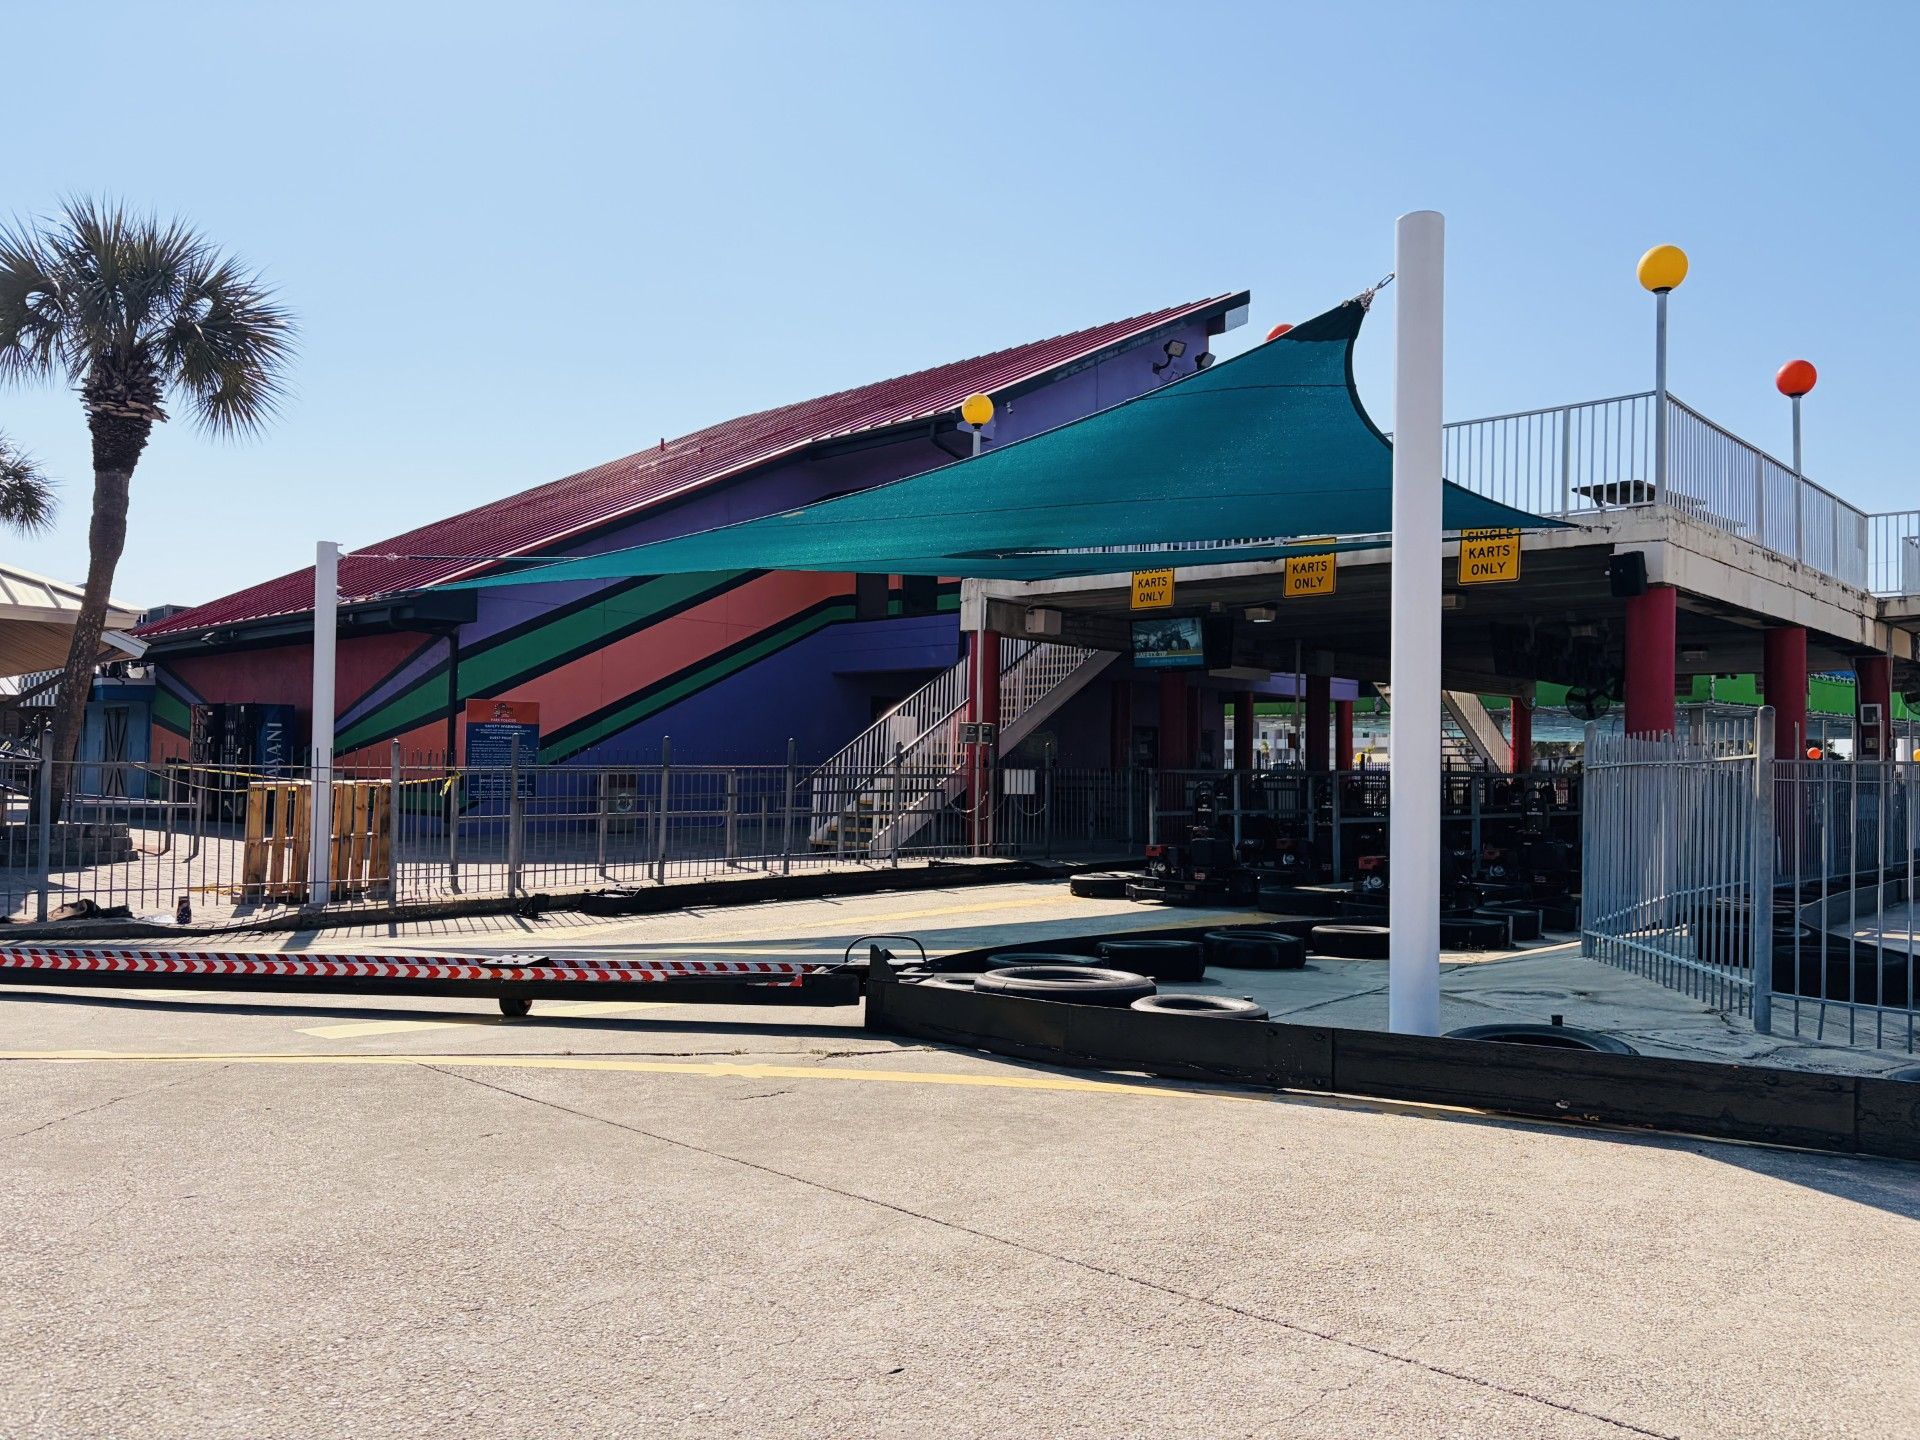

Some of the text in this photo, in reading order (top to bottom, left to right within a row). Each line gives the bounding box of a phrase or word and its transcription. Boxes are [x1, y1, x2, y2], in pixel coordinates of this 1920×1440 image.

[1468, 545, 1510, 559] KARTS
[1292, 561, 1327, 574] KARTS
[1471, 561, 1506, 576] ONLY
[1138, 576, 1167, 589] KARTS
[1294, 576, 1324, 590] ONLY
[1139, 591, 1164, 602] ONLY
[265, 723, 285, 778] ASANI
